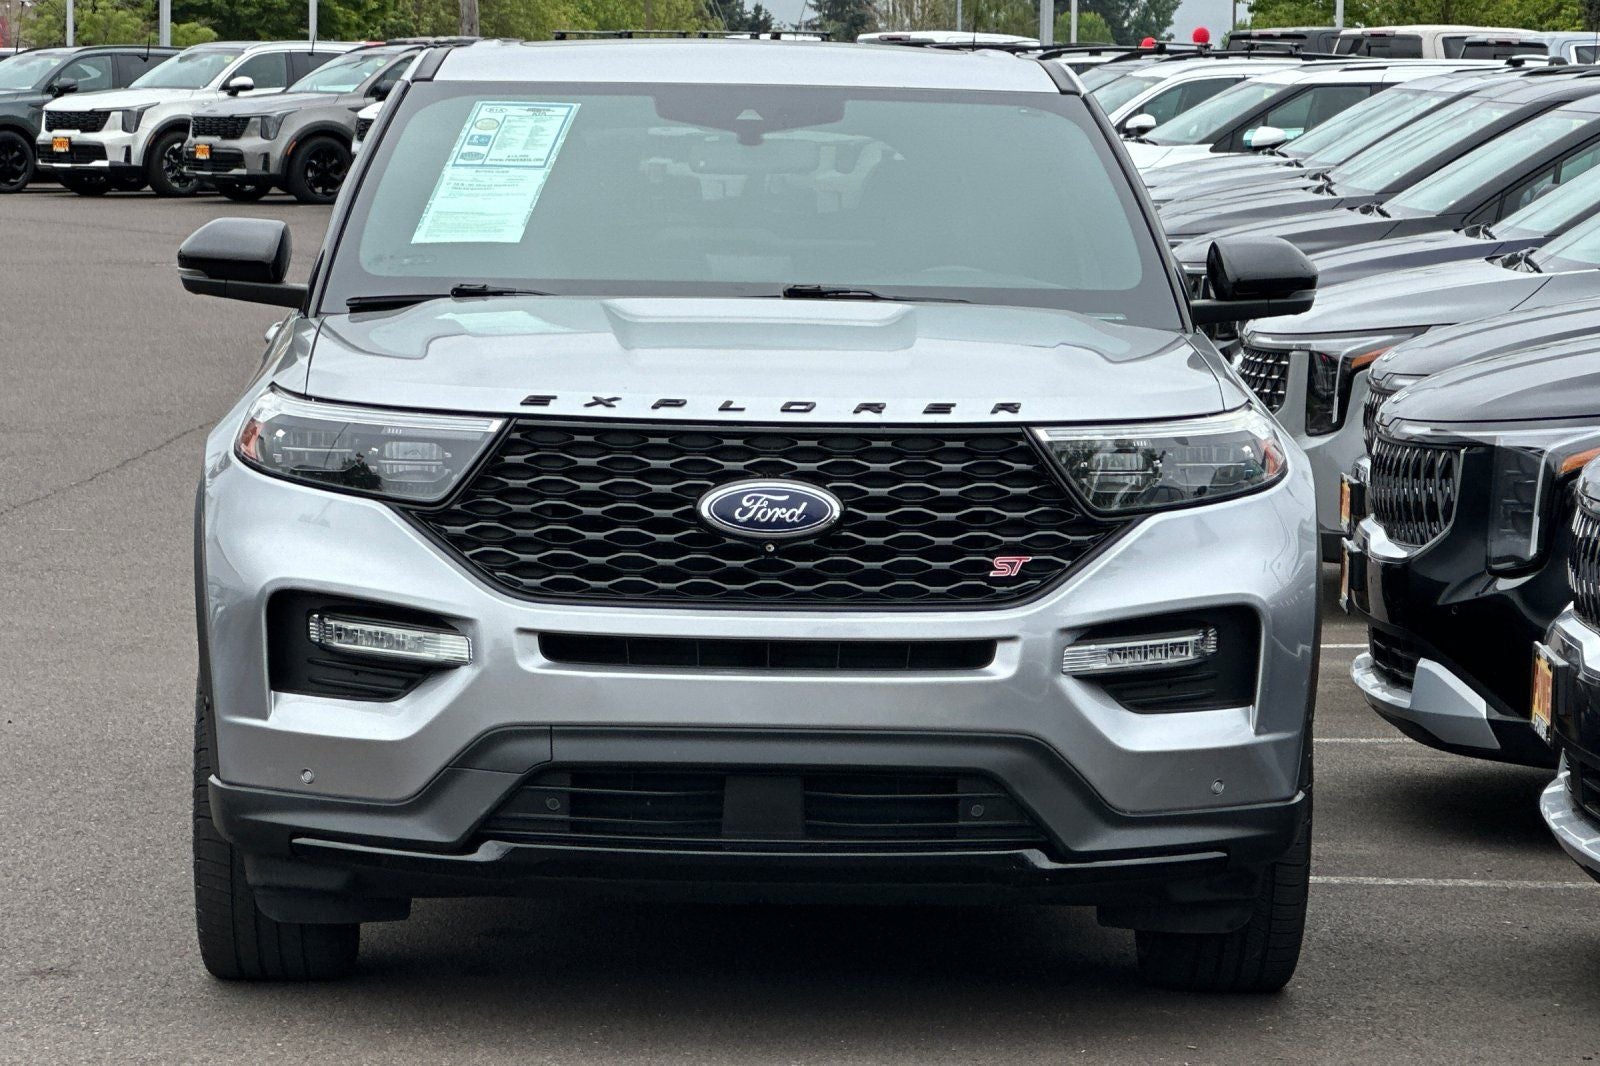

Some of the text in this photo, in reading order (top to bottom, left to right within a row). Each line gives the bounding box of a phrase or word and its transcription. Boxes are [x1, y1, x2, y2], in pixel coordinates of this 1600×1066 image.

[520, 394, 1022, 415] EXPLORER
[734, 492, 807, 523] Ford
[989, 556, 1033, 577] ST
